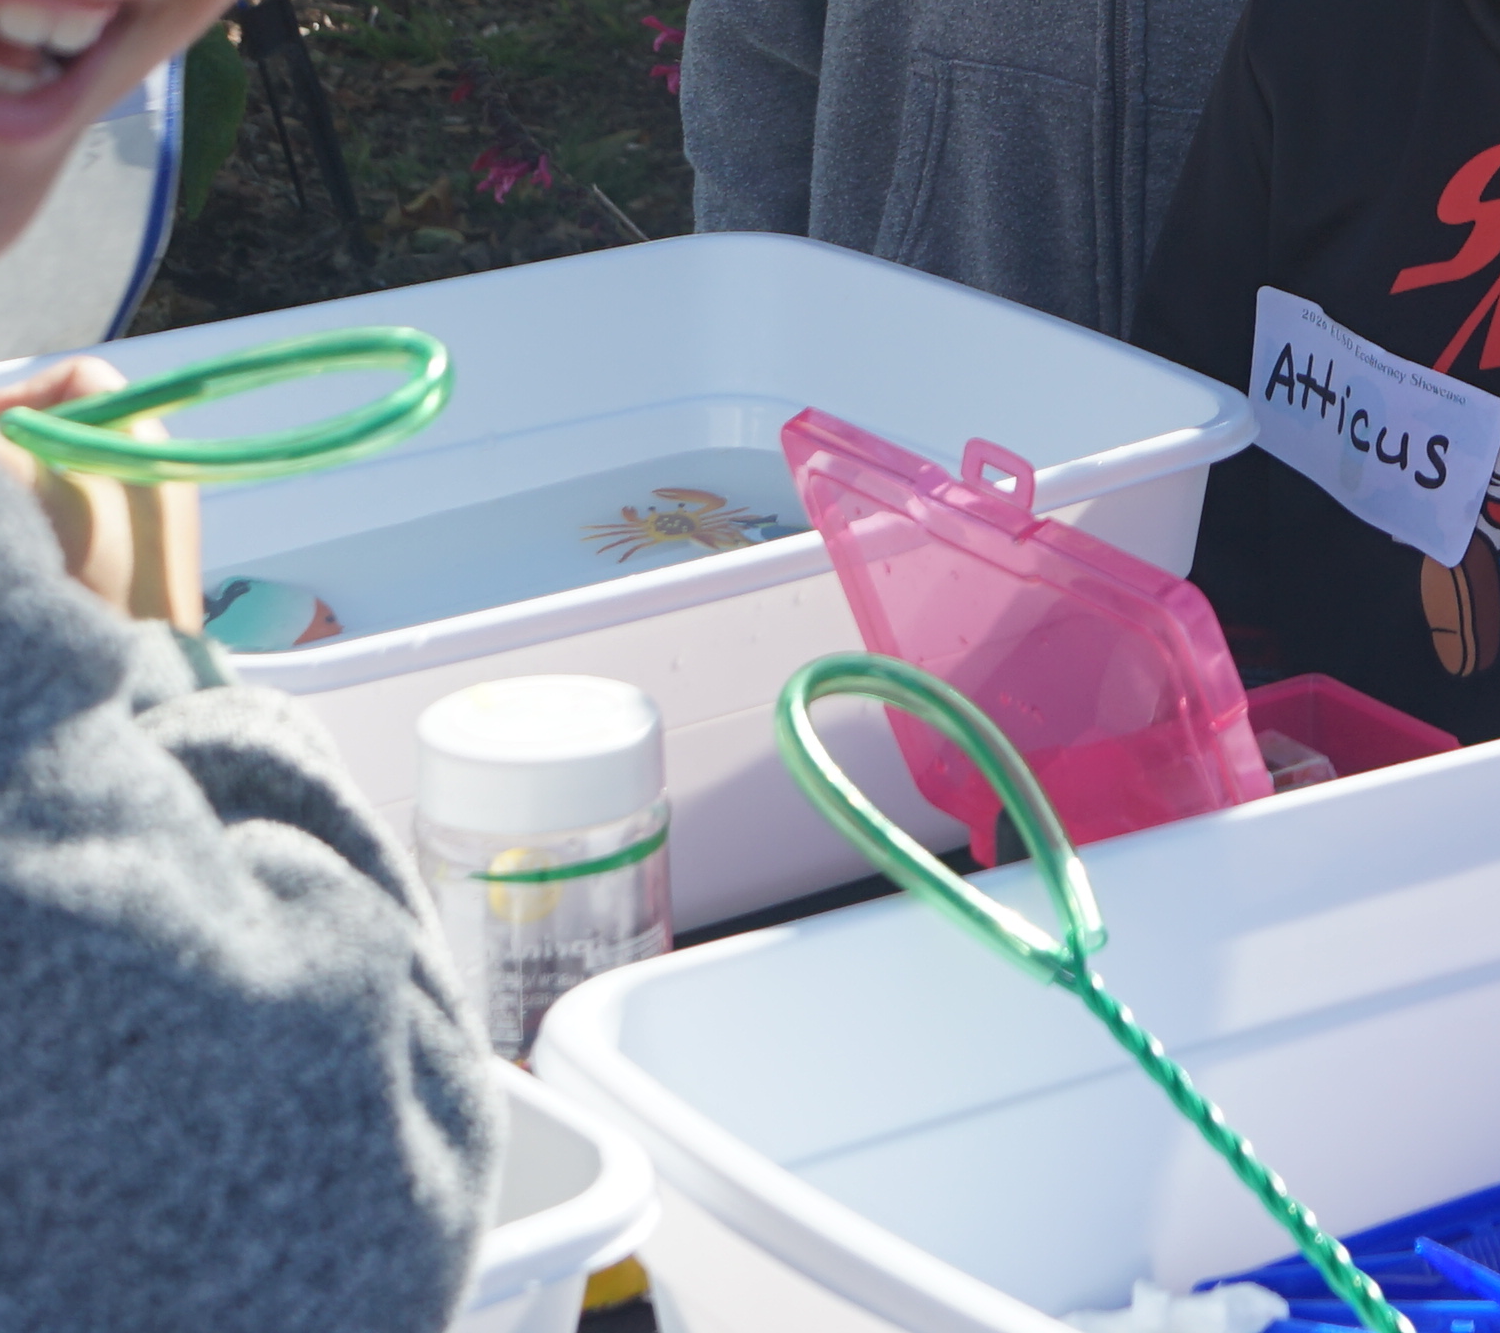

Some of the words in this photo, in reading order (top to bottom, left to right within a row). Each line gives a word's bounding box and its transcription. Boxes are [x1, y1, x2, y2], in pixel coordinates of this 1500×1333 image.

[1264, 341, 1450, 490] Atticus
[1301, 307, 1328, 330] 2026
[1330, 324, 1354, 352] EUSD
[1409, 372, 1468, 406] Showcase
